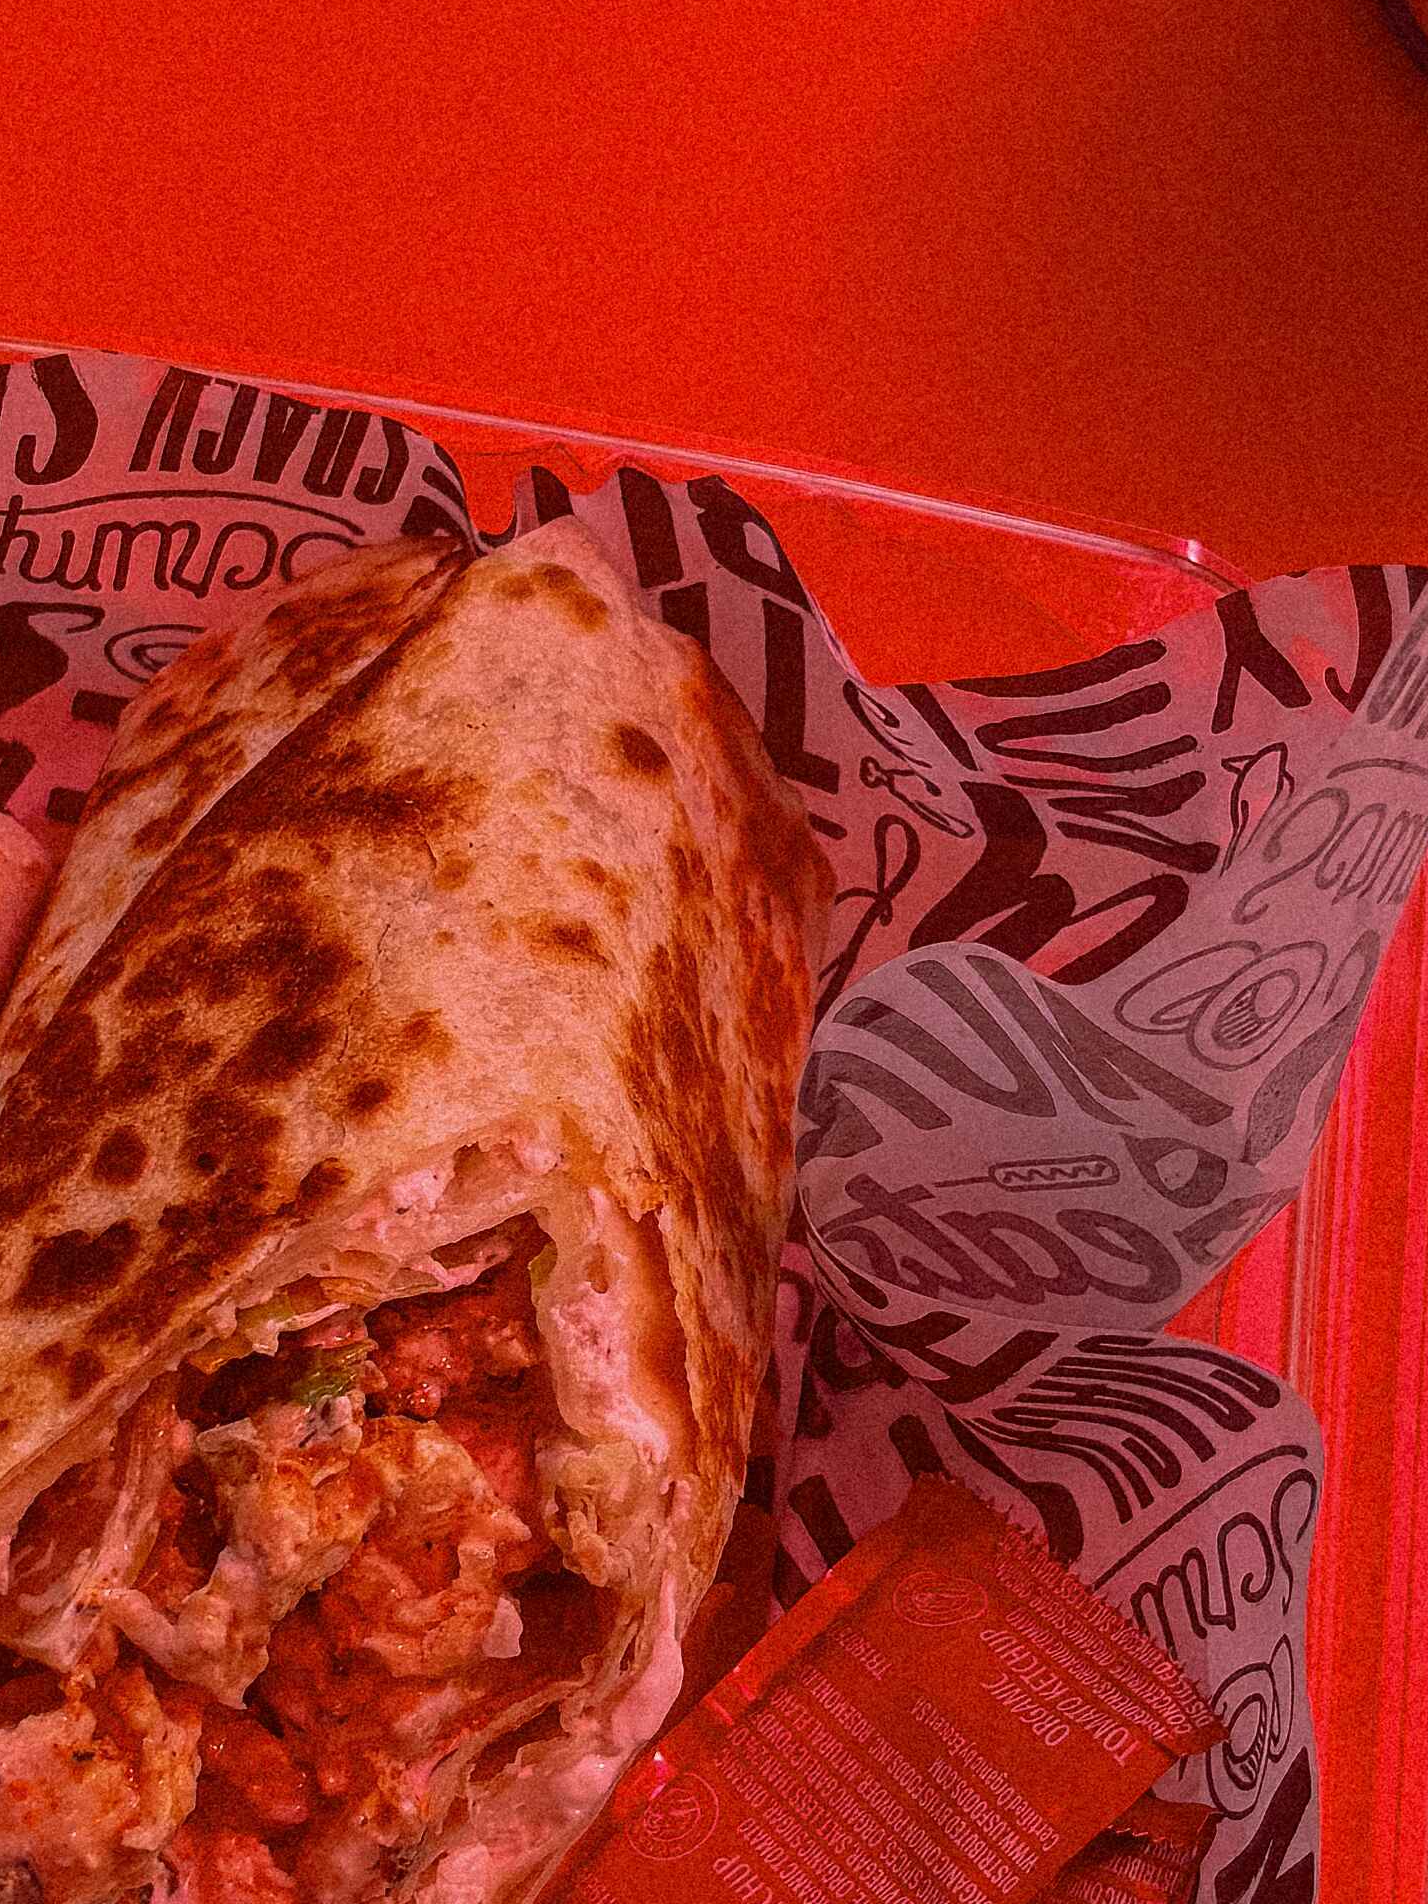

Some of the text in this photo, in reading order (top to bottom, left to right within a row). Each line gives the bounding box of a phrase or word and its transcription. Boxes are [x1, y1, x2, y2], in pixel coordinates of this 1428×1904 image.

[978, 1618, 1143, 1766] TOMATO KETCHUP
[980, 1666, 1072, 1750] ORGANIC
[757, 1754, 799, 1798] THAN
[787, 1745, 840, 1800] GARLIC
[803, 1719, 864, 1783] NATURAL
[907, 1694, 1062, 1852] Certified Organic by Ecocert SA
[786, 1784, 826, 1826] LESS
[826, 1785, 888, 1849] ORGANIC
[851, 1769, 912, 1833] POWDER,
[924, 1755, 1041, 1873] WWW.USFOODS.COM
[733, 1814, 789, 1873] TOMATO
[797, 1836, 856, 1897] ORGANIC
[874, 1835, 927, 1890] SPICES,
[899, 1819, 944, 1866] ONION
[942, 1812, 1021, 1894] DISTRIBUTED
